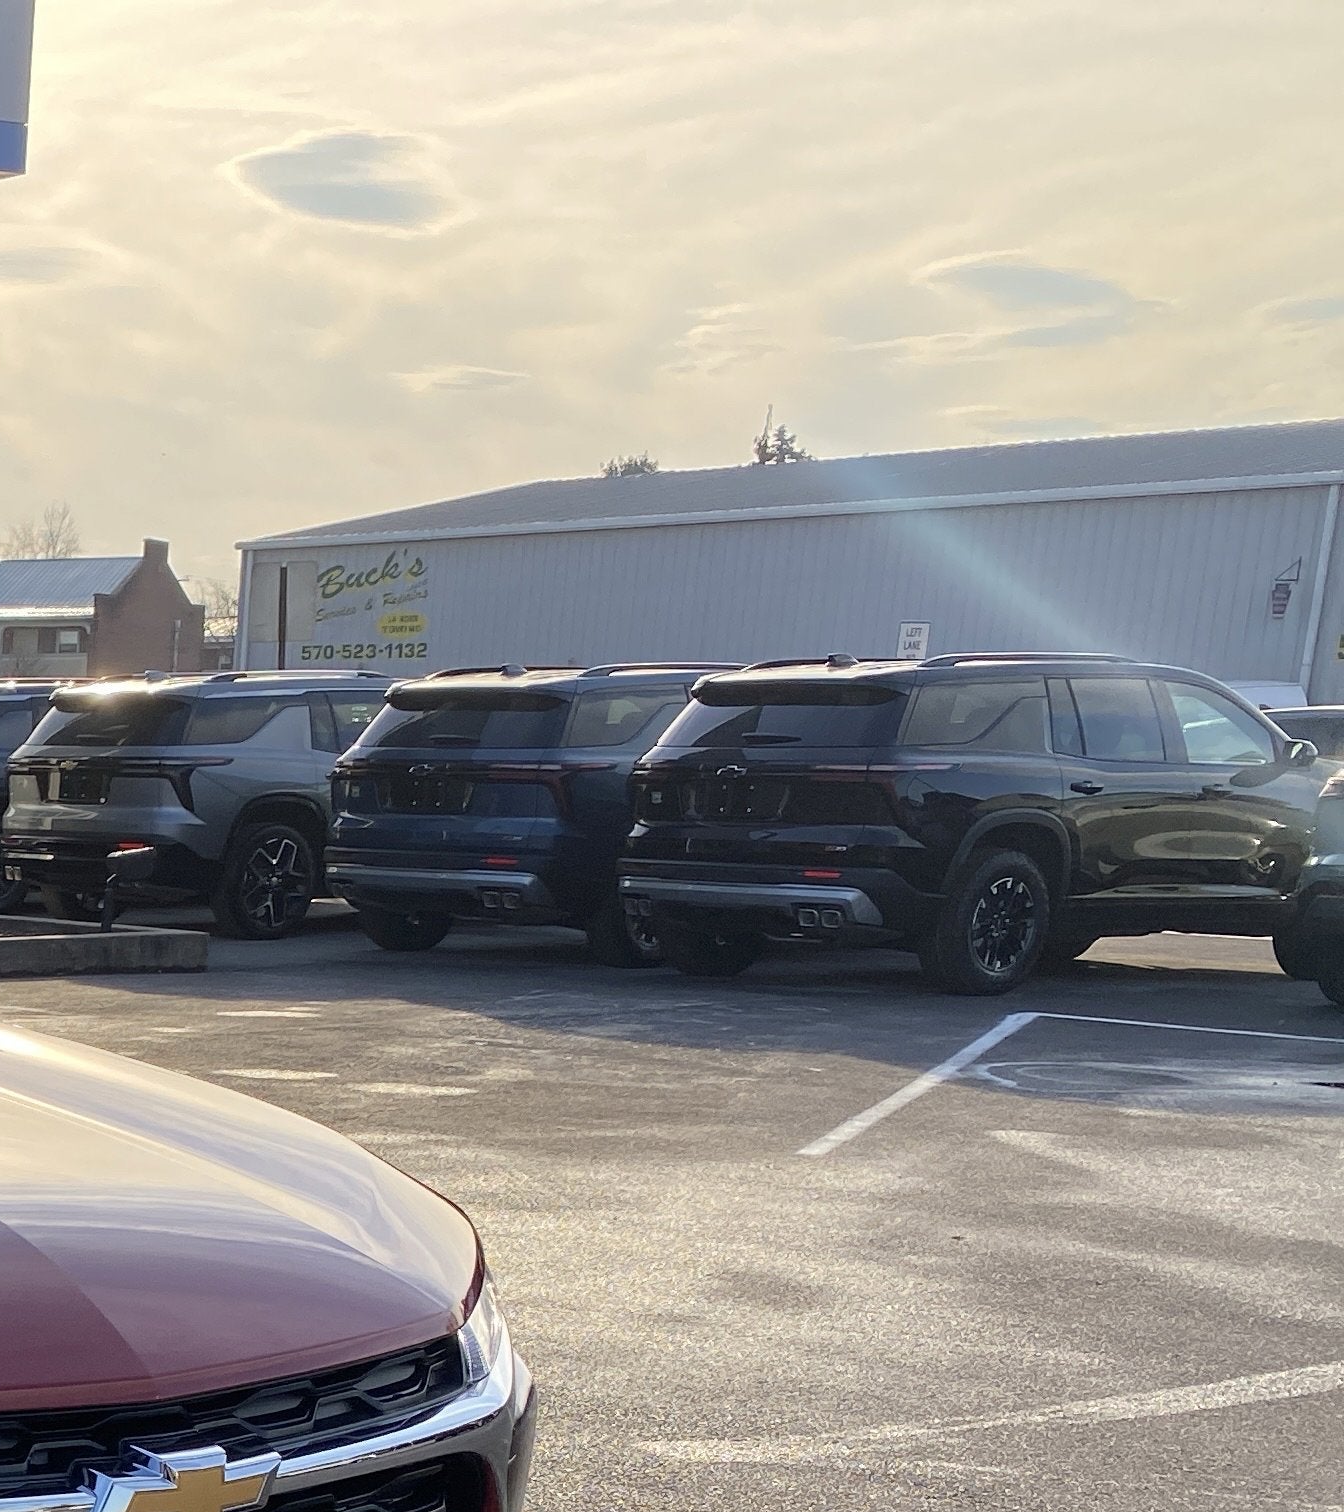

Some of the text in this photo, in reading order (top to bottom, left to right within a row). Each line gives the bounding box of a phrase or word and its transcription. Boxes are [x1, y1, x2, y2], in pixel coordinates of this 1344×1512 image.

[316, 548, 429, 599] Buck's
[906, 627, 923, 637] LEFT
[301, 642, 428, 660] 570-523-1132
